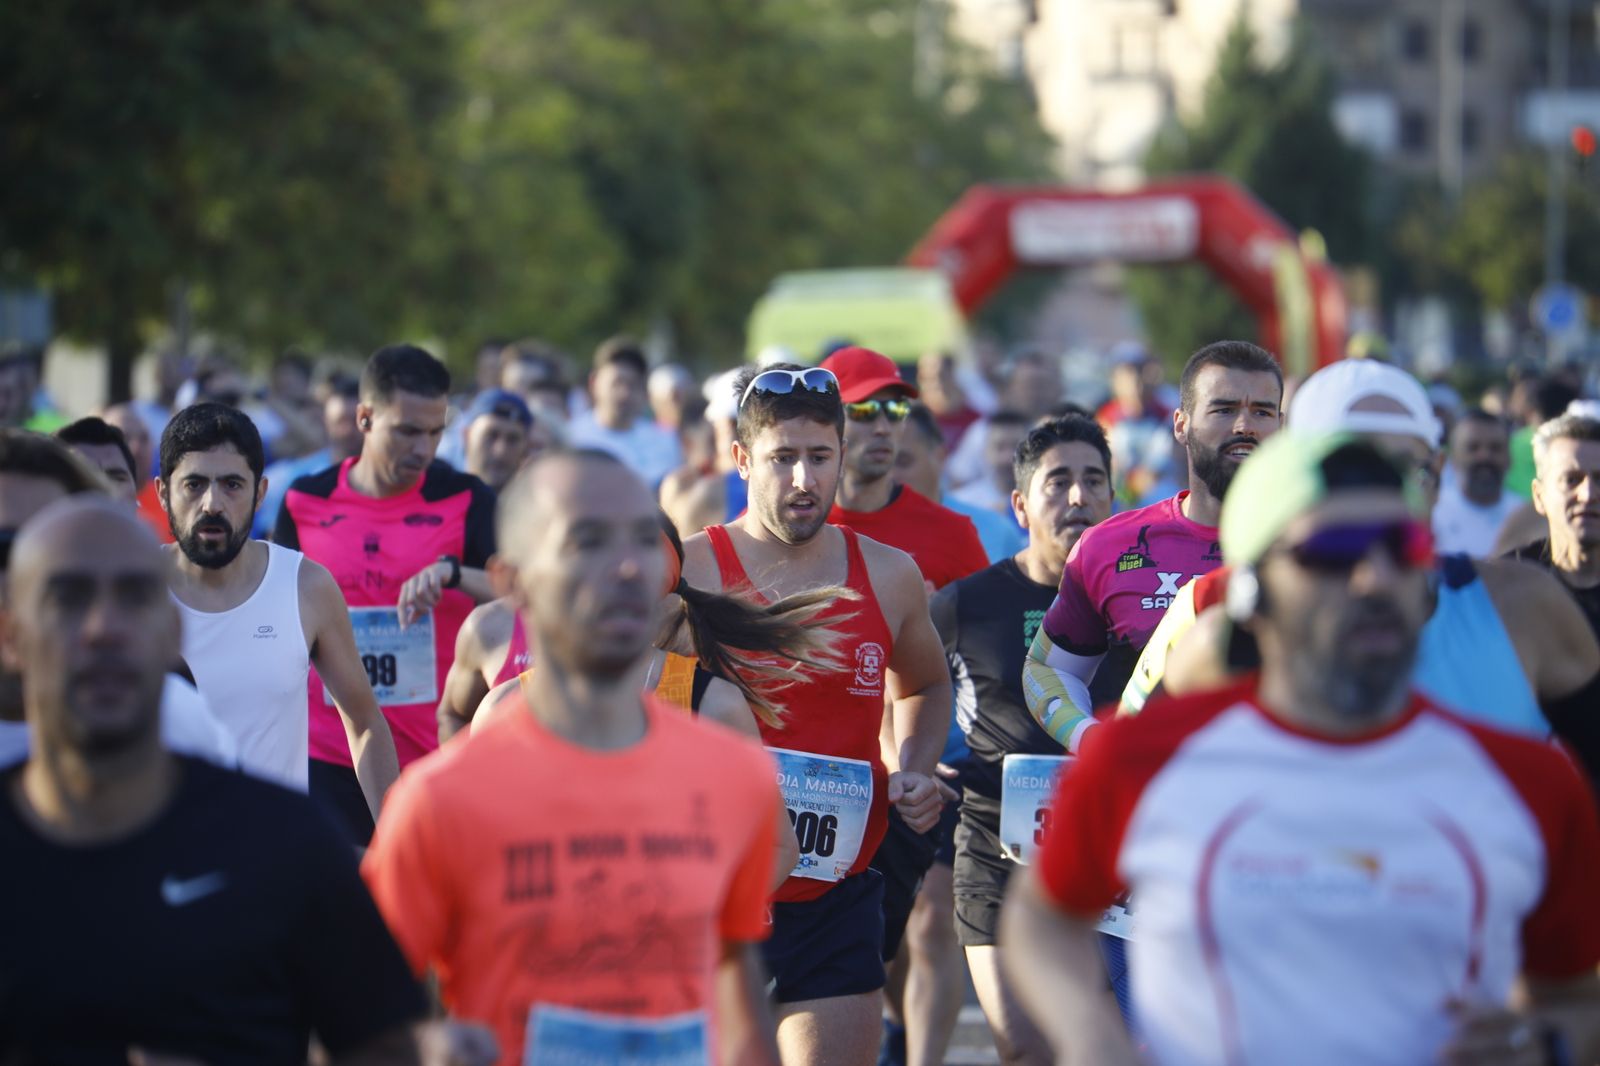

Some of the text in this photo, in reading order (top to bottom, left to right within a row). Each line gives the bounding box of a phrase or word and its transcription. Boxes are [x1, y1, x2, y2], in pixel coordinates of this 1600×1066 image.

[775, 772, 799, 788] DIA
[805, 777, 869, 799] MARATÓN
[1009, 776, 1051, 789] MEDIA
